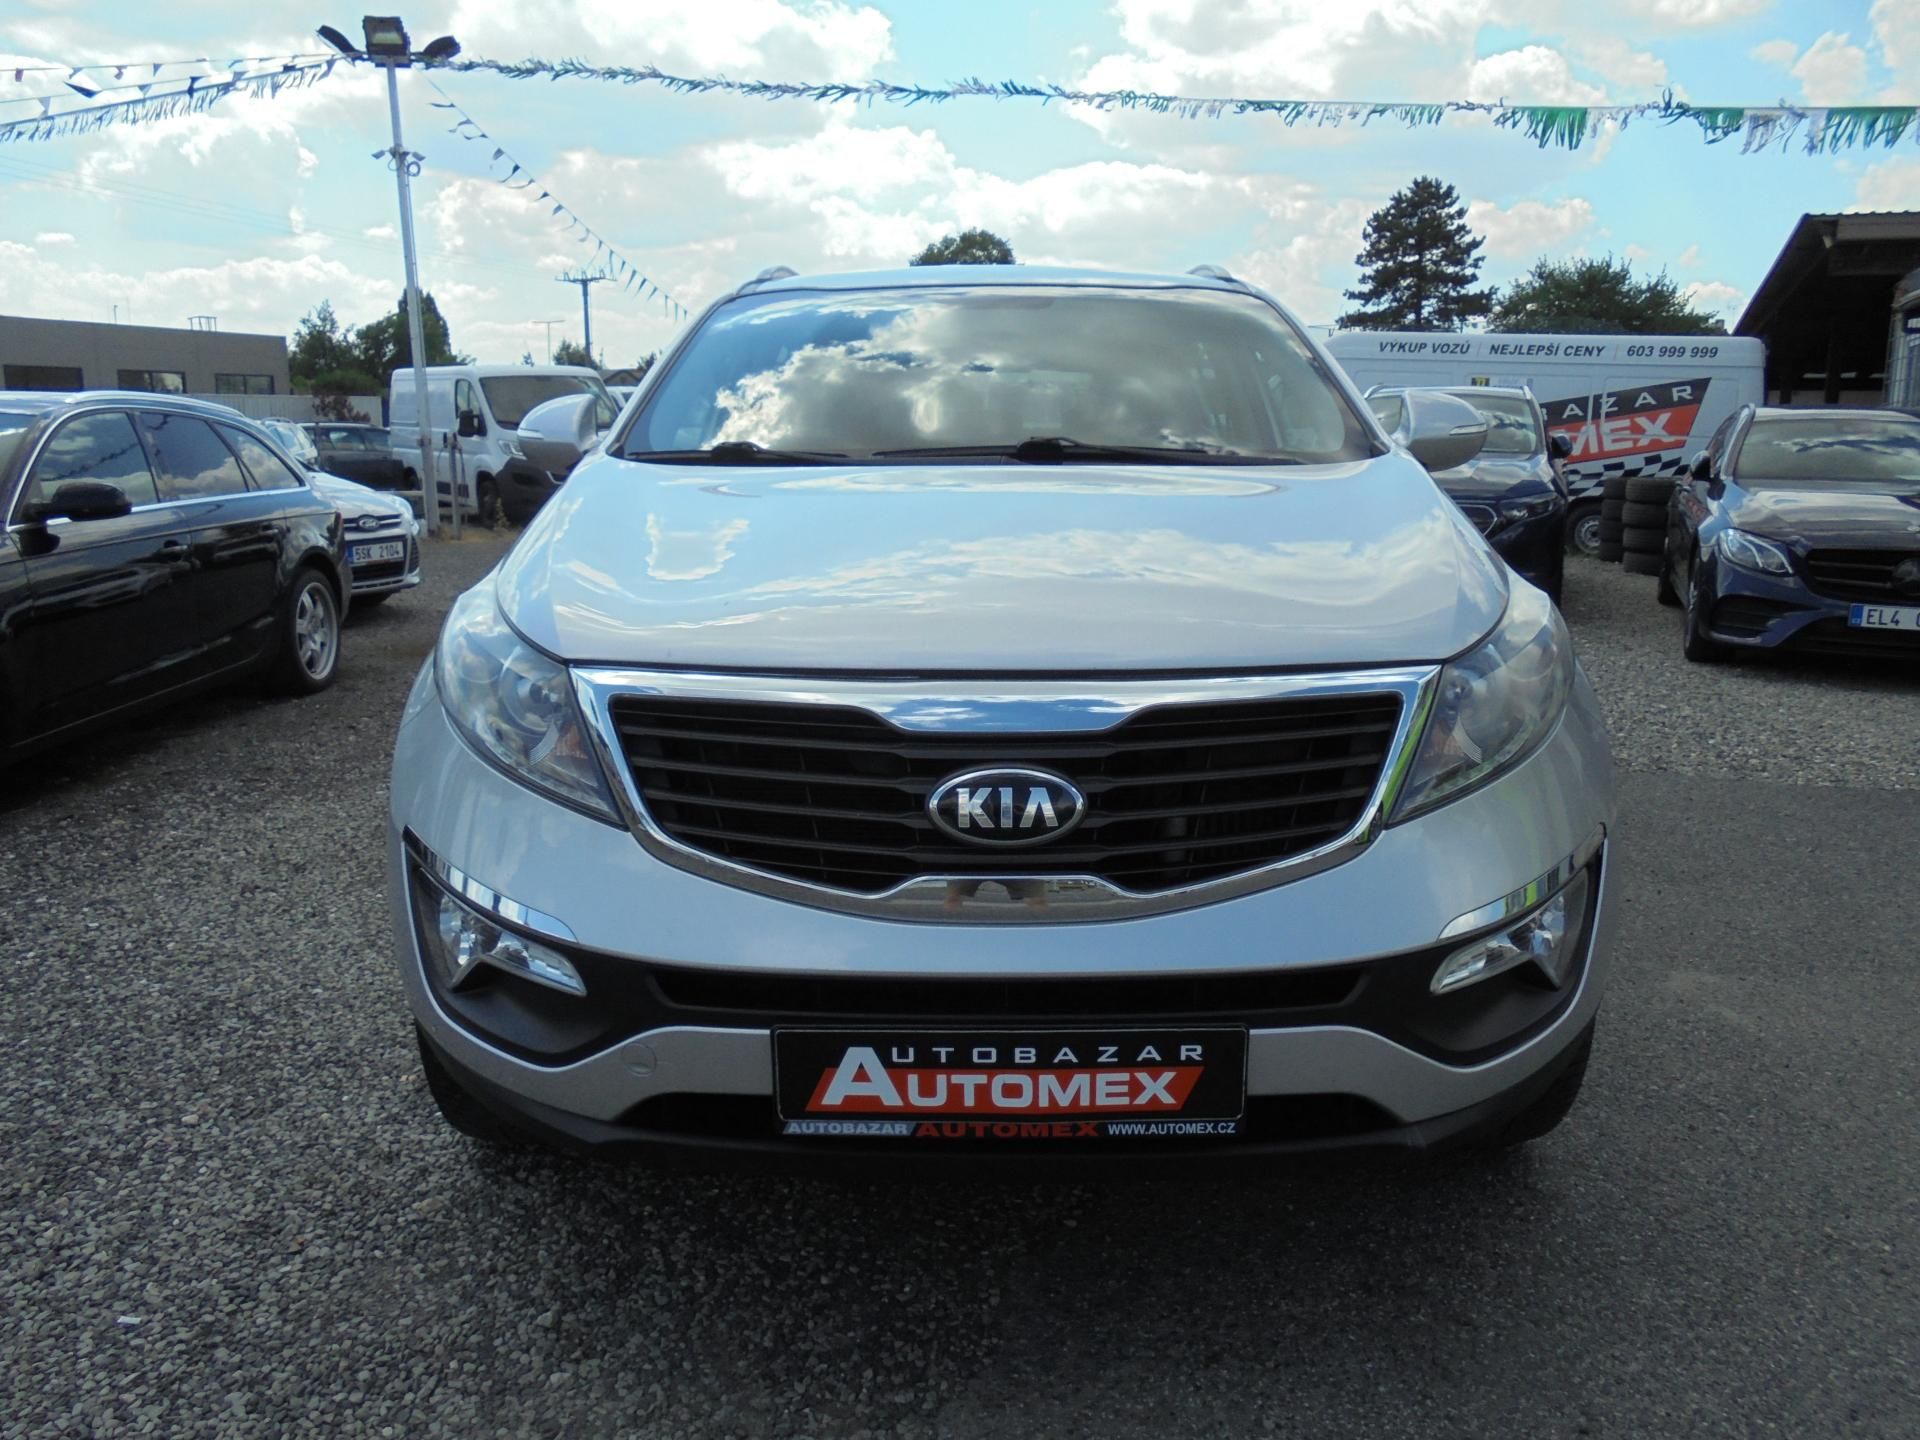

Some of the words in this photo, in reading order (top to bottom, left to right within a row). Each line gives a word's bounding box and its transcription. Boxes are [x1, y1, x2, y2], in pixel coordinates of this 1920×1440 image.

[1563, 345, 1606, 358] CENY
[1626, 345, 1654, 358] 603
[1658, 346, 1686, 359] 999
[1690, 346, 1719, 359] 999
[1541, 385, 1694, 421] AZAR
[355, 546, 372, 561] 5SK
[1866, 608, 1900, 626] EL4
[955, 787, 1059, 829] KIA
[787, 1122, 909, 1135] AUTOBAZAR
[915, 1122, 1099, 1138] AUTOMEX
[1107, 1122, 1236, 1136] WWW.AUTOMEX.CZ
